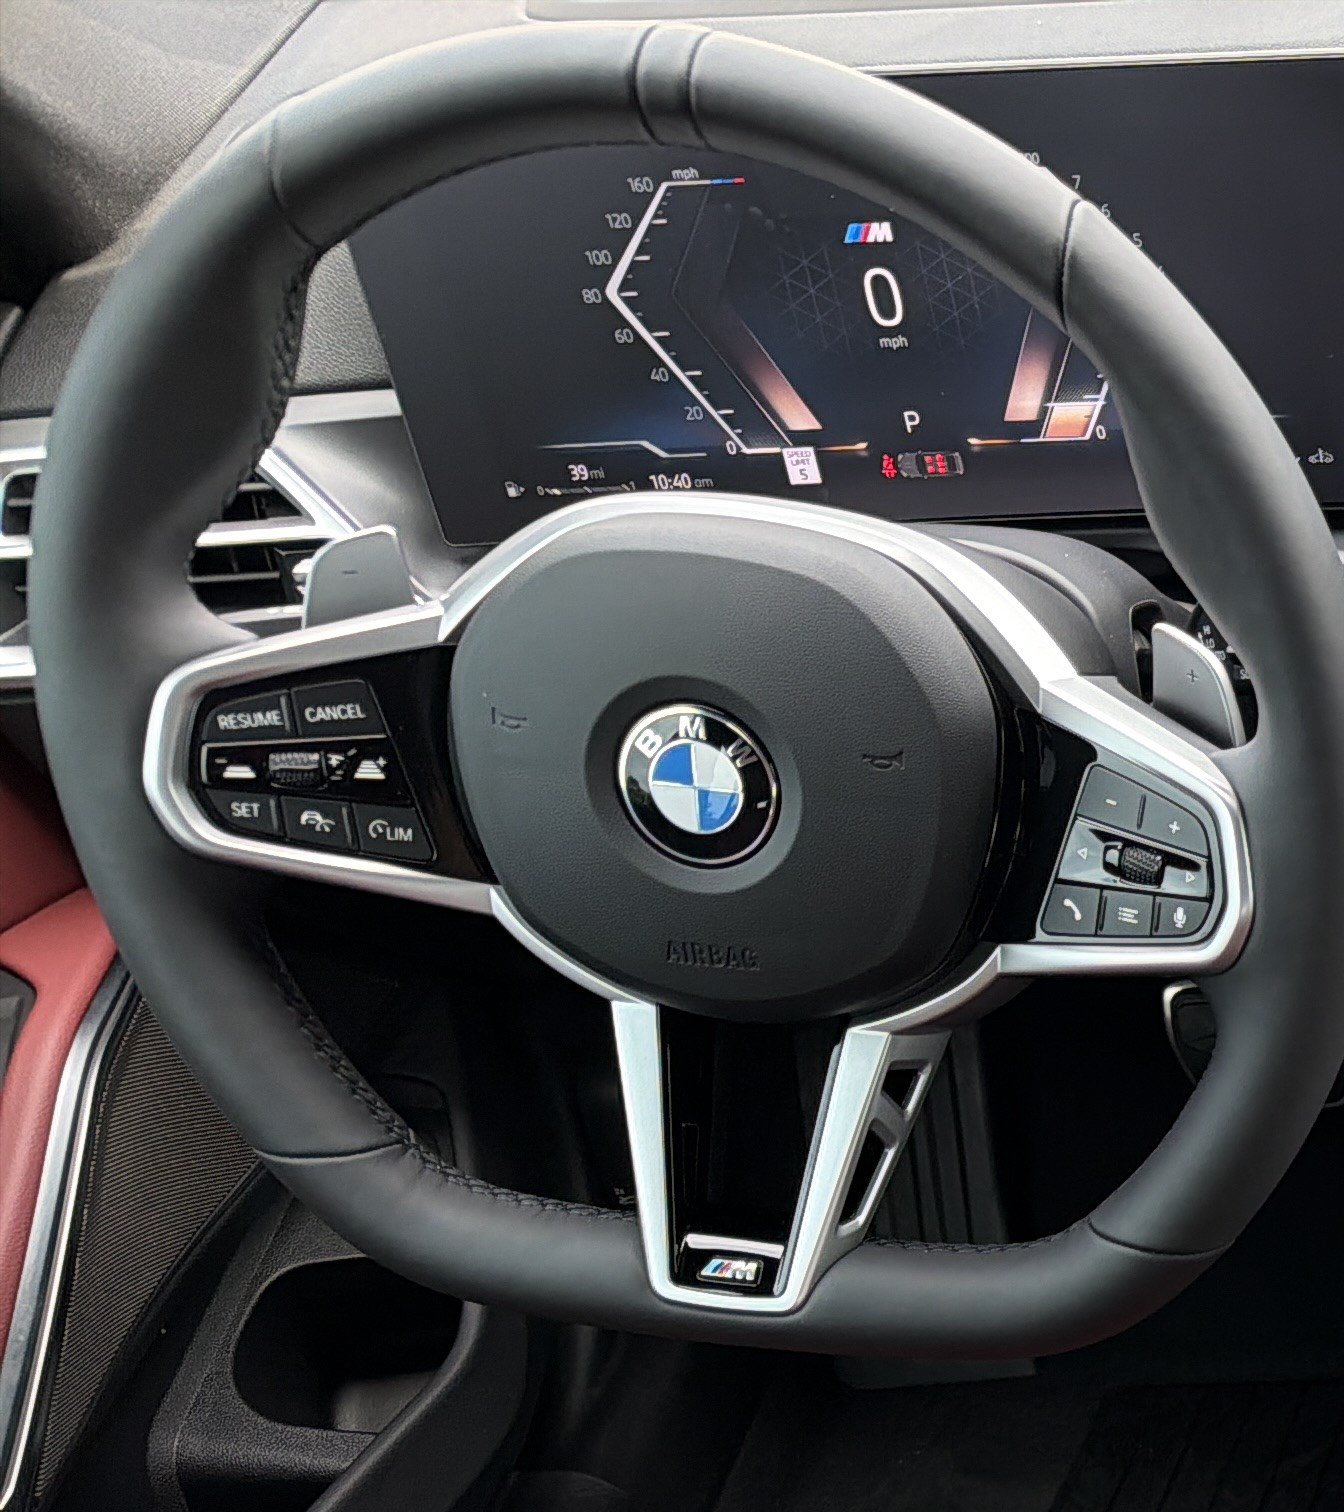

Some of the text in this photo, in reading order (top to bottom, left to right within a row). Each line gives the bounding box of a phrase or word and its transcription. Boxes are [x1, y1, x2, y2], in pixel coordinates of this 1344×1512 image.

[671, 167, 699, 182] mph
[1072, 174, 1081, 190] 7
[627, 177, 654, 193] 160
[604, 213, 632, 229] 120
[584, 250, 612, 266] 100
[582, 289, 602, 304] 80
[862, 266, 904, 328] 0
[614, 328, 634, 344] 60
[879, 335, 909, 350] mph
[650, 367, 669, 384] 40
[684, 405, 704, 421] 20
[903, 411, 921, 434] P
[1096, 425, 1106, 440] 0
[725, 440, 737, 455] 0
[568, 464, 589, 482] 39
[799, 468, 809, 481] 5
[649, 473, 714, 490] 10:40 am
[536, 485, 545, 496] 0
[216, 709, 285, 731] RESUME
[304, 703, 367, 723] CANCEL
[634, 715, 759, 770] BMW
[230, 802, 261, 818] SET
[385, 827, 413, 842] LIM
